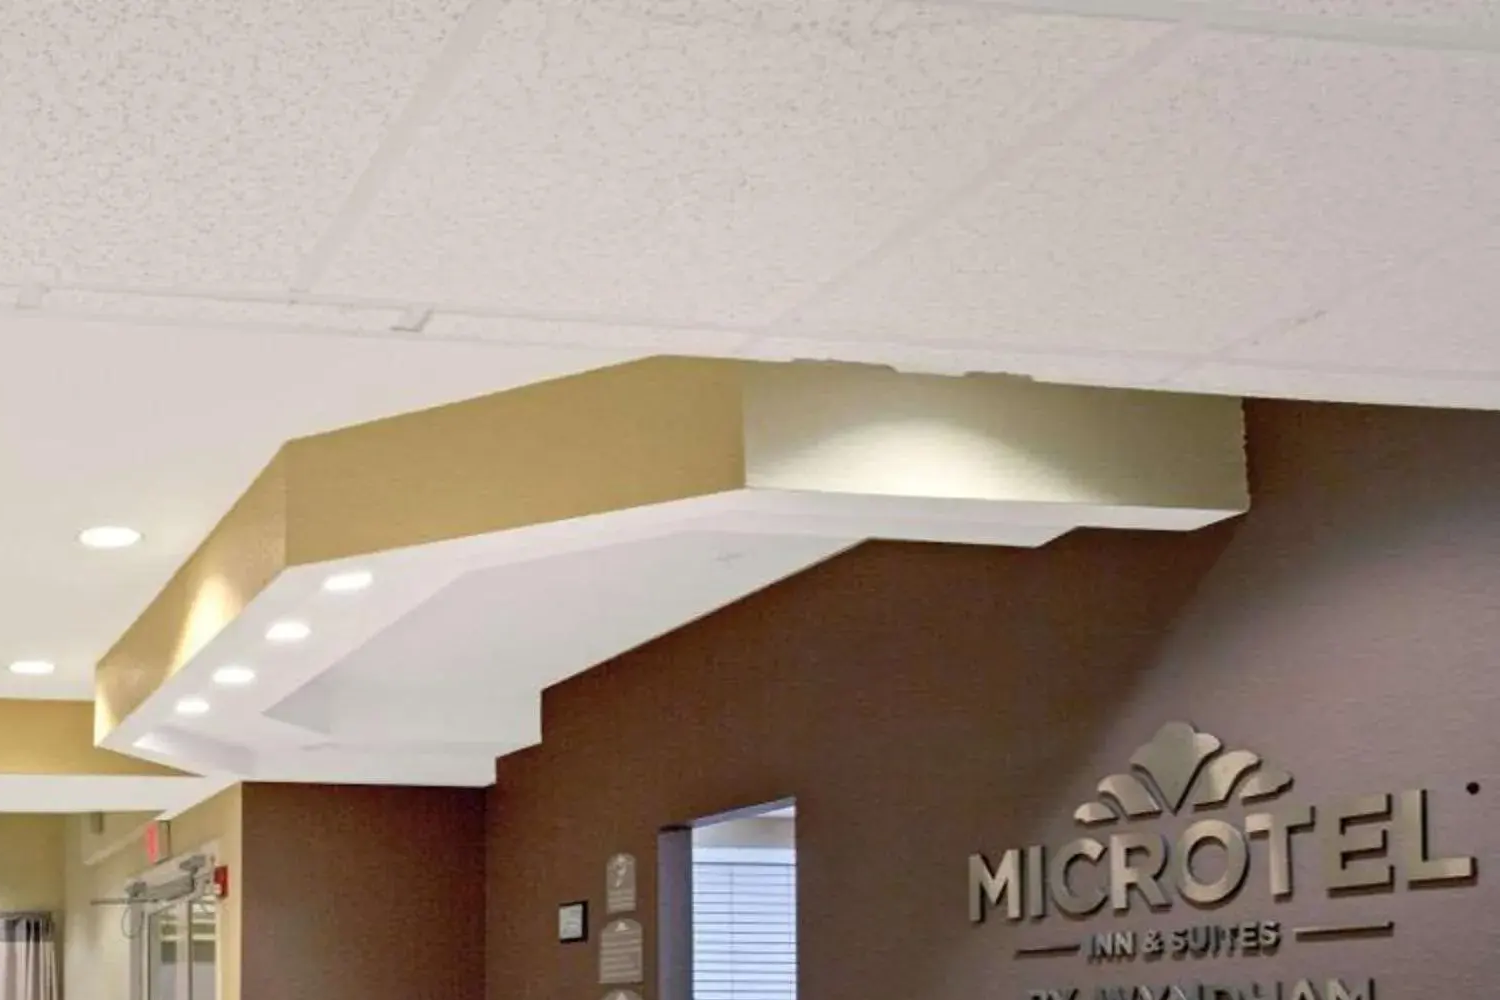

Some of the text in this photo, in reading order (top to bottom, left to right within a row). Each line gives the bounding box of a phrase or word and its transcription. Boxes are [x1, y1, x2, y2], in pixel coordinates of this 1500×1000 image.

[968, 789, 1477, 923] MICROTEL
[1087, 920, 1280, 962] INN & SUITES
